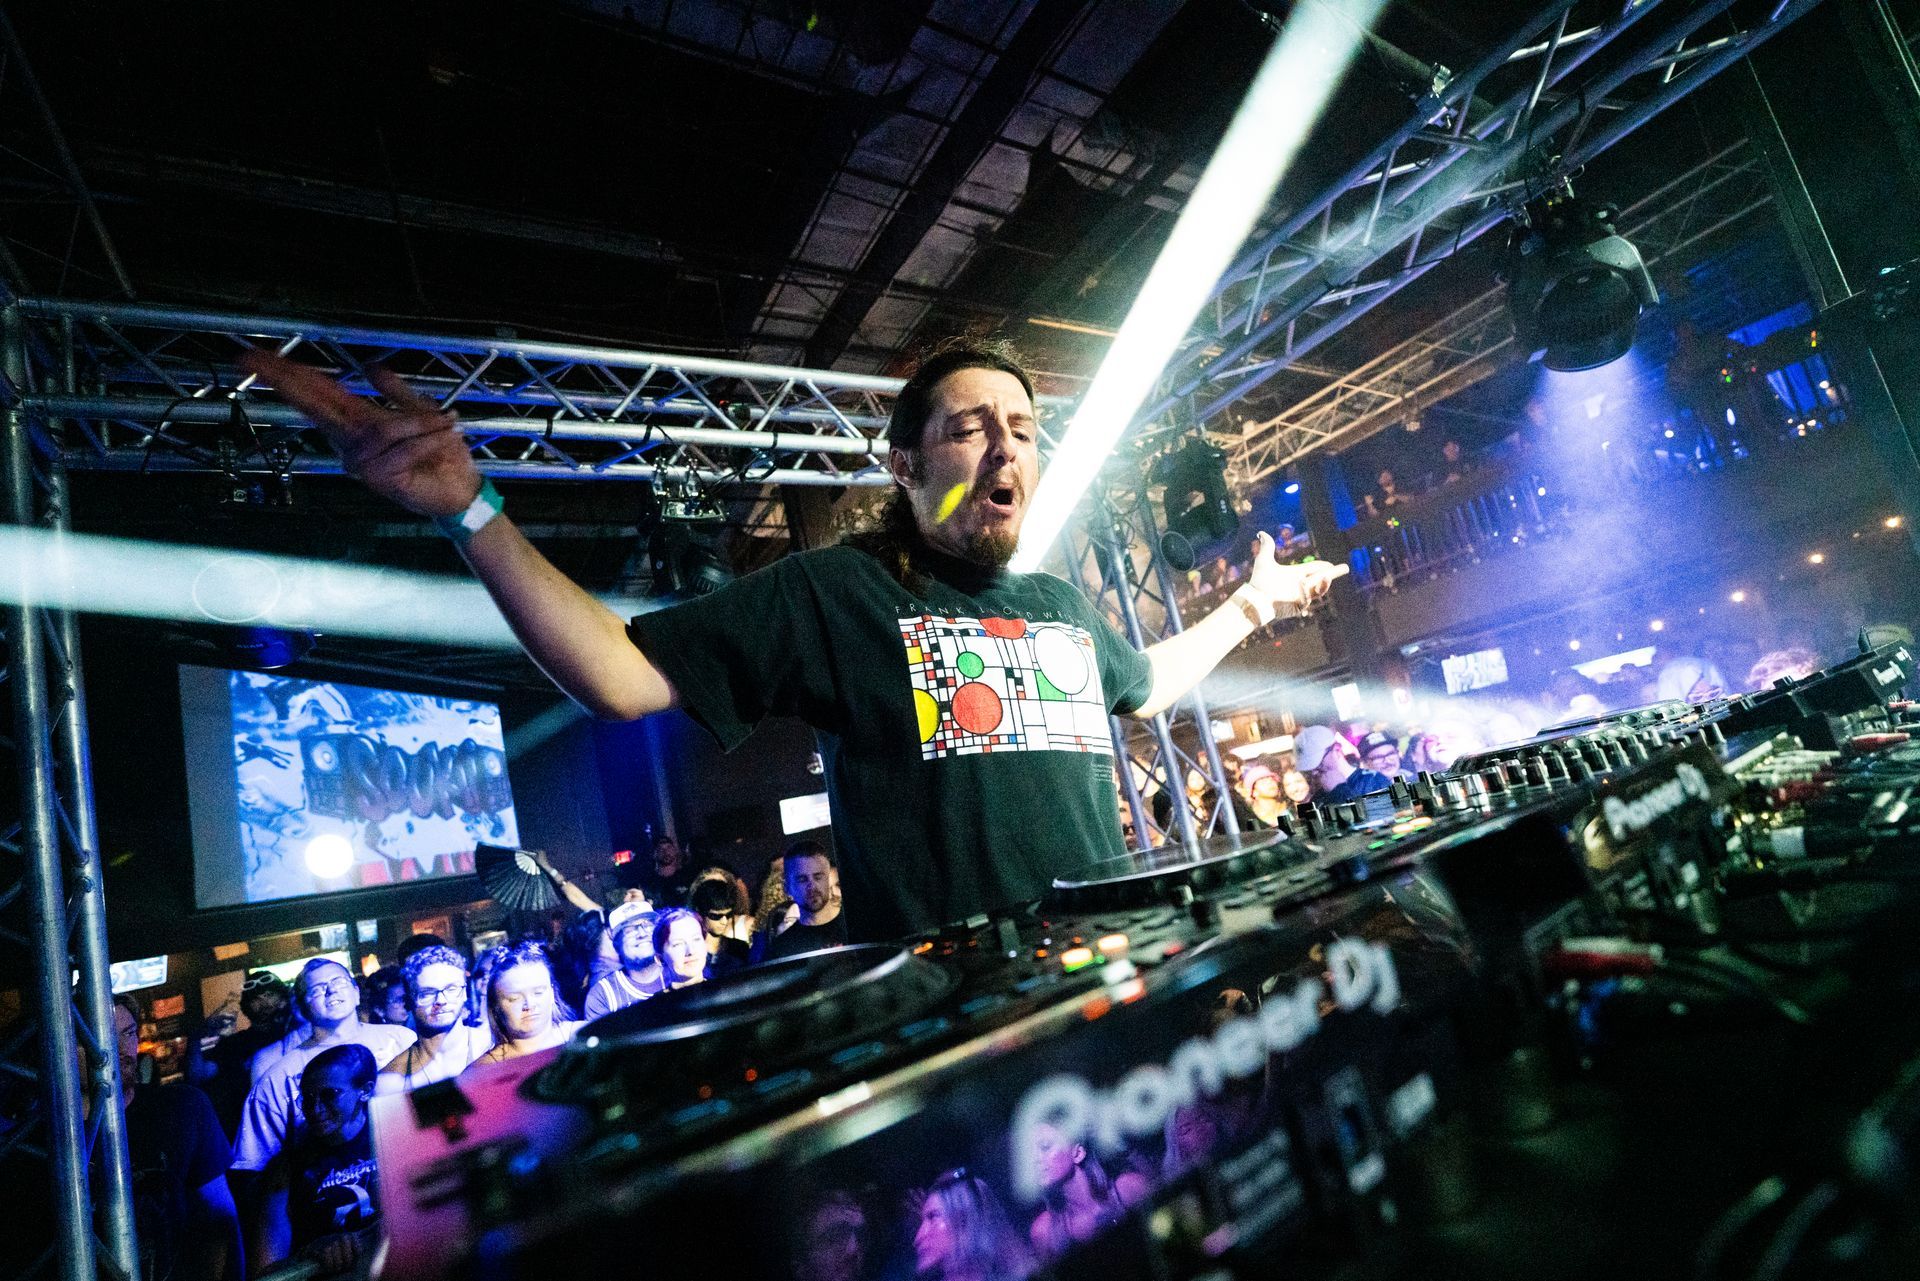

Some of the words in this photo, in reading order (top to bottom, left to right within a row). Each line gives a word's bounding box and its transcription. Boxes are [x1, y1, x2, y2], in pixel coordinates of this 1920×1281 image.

[895, 603, 965, 615] FRANK
[1010, 976, 1325, 1204] Pioneer
[1325, 936, 1400, 1017] DJ
